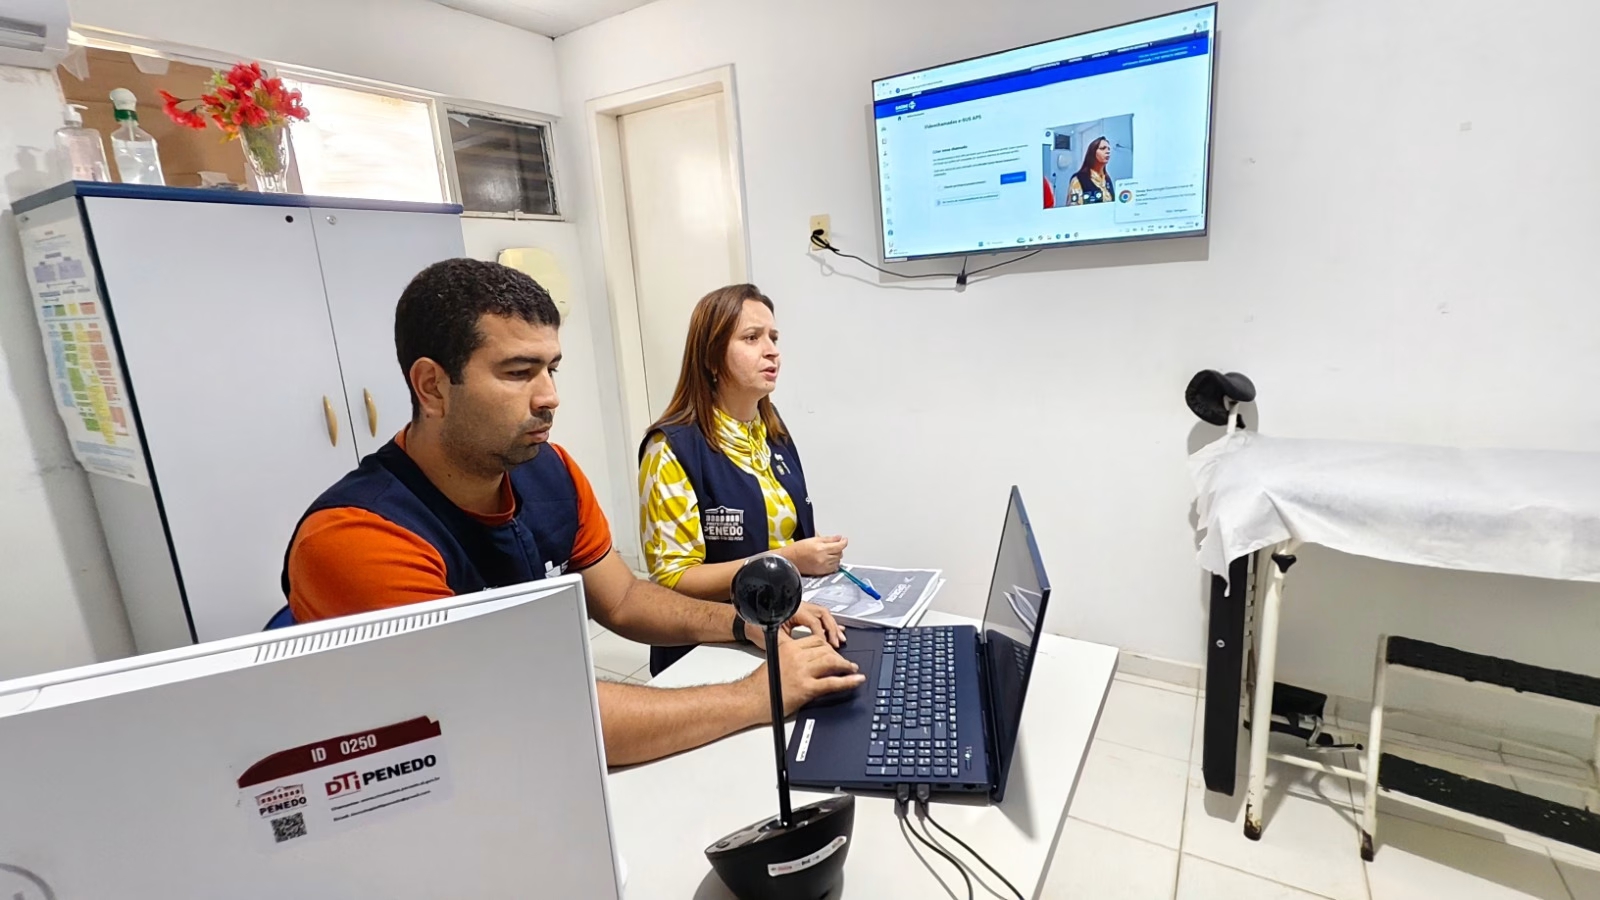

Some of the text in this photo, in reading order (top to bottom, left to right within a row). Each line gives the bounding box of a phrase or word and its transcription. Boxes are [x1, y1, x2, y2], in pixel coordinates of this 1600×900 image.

[311, 734, 377, 763] ID 0250
[362, 754, 437, 785] PENEDO
[259, 796, 308, 816] PENEDO
